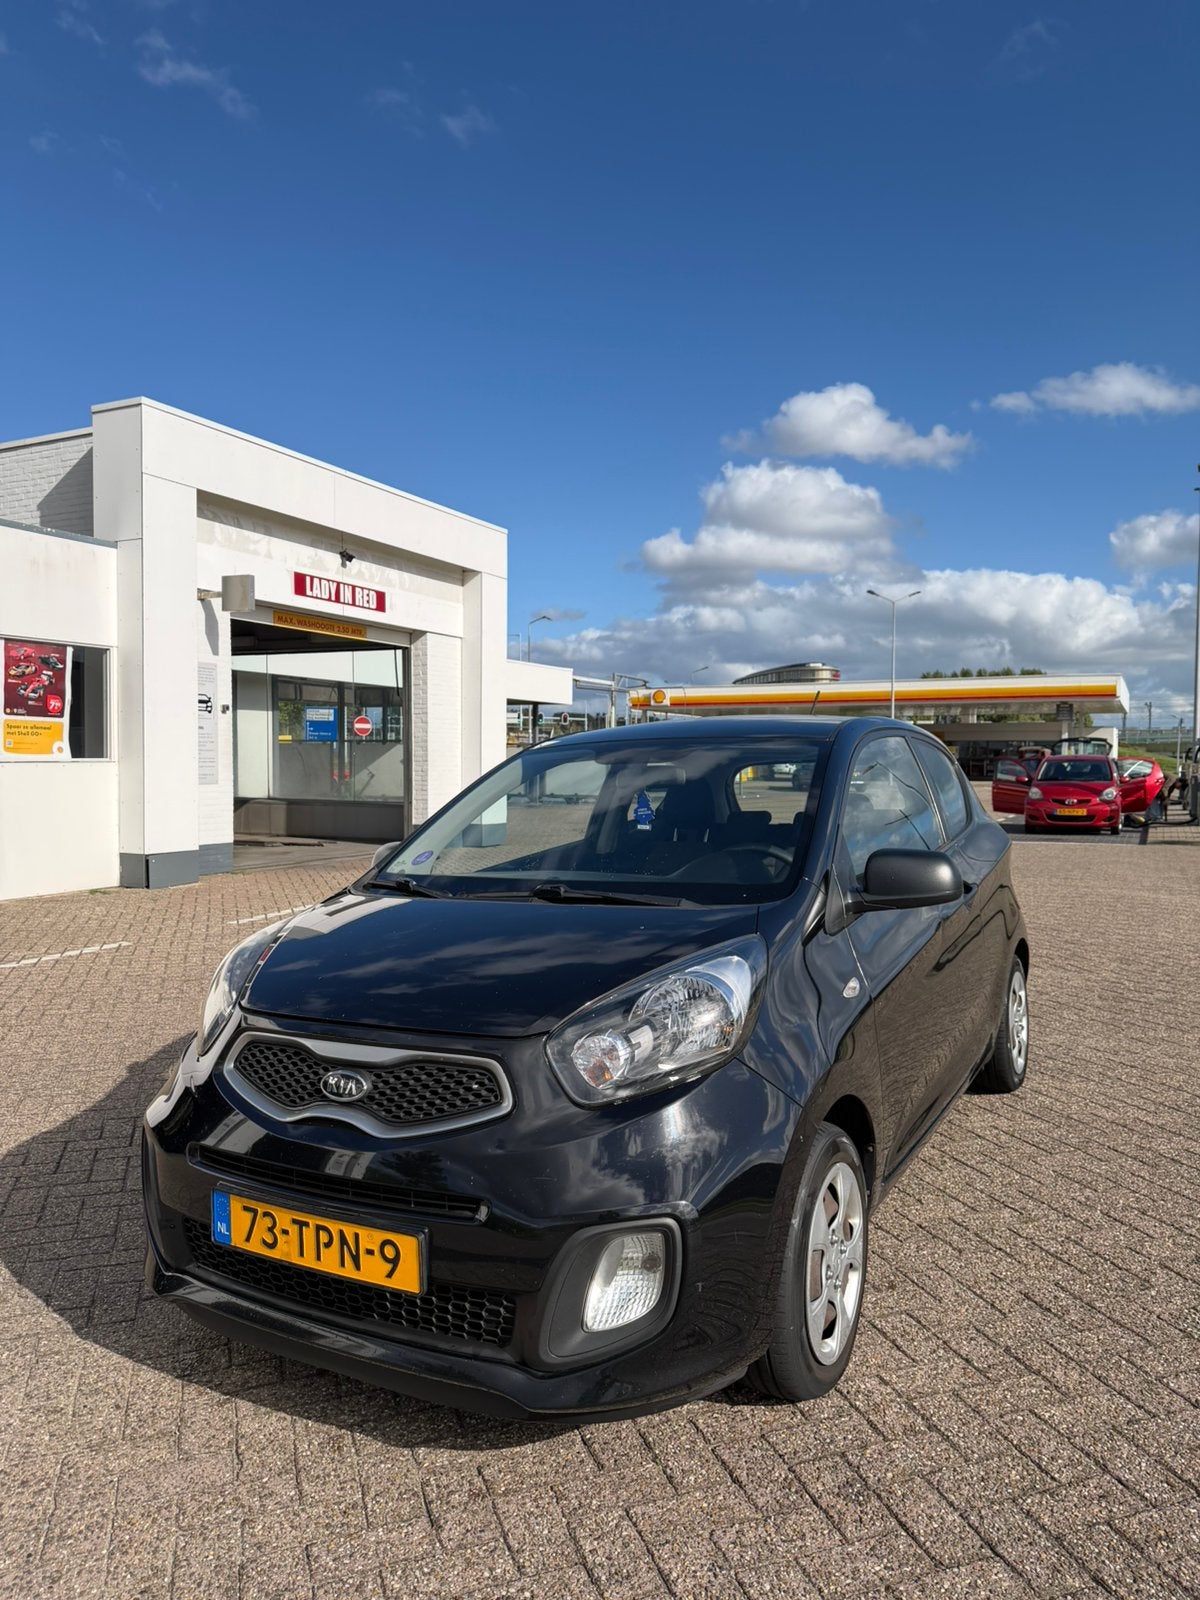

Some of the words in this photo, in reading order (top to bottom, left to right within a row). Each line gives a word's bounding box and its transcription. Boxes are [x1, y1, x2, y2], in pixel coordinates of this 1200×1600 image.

[305, 575, 338, 601] LADY
[339, 583, 353, 605] IN
[355, 586, 377, 610] RED
[326, 1075, 358, 1096] KIA
[217, 1221, 230, 1236] NL
[241, 1205, 402, 1279] 73-TPN-9
